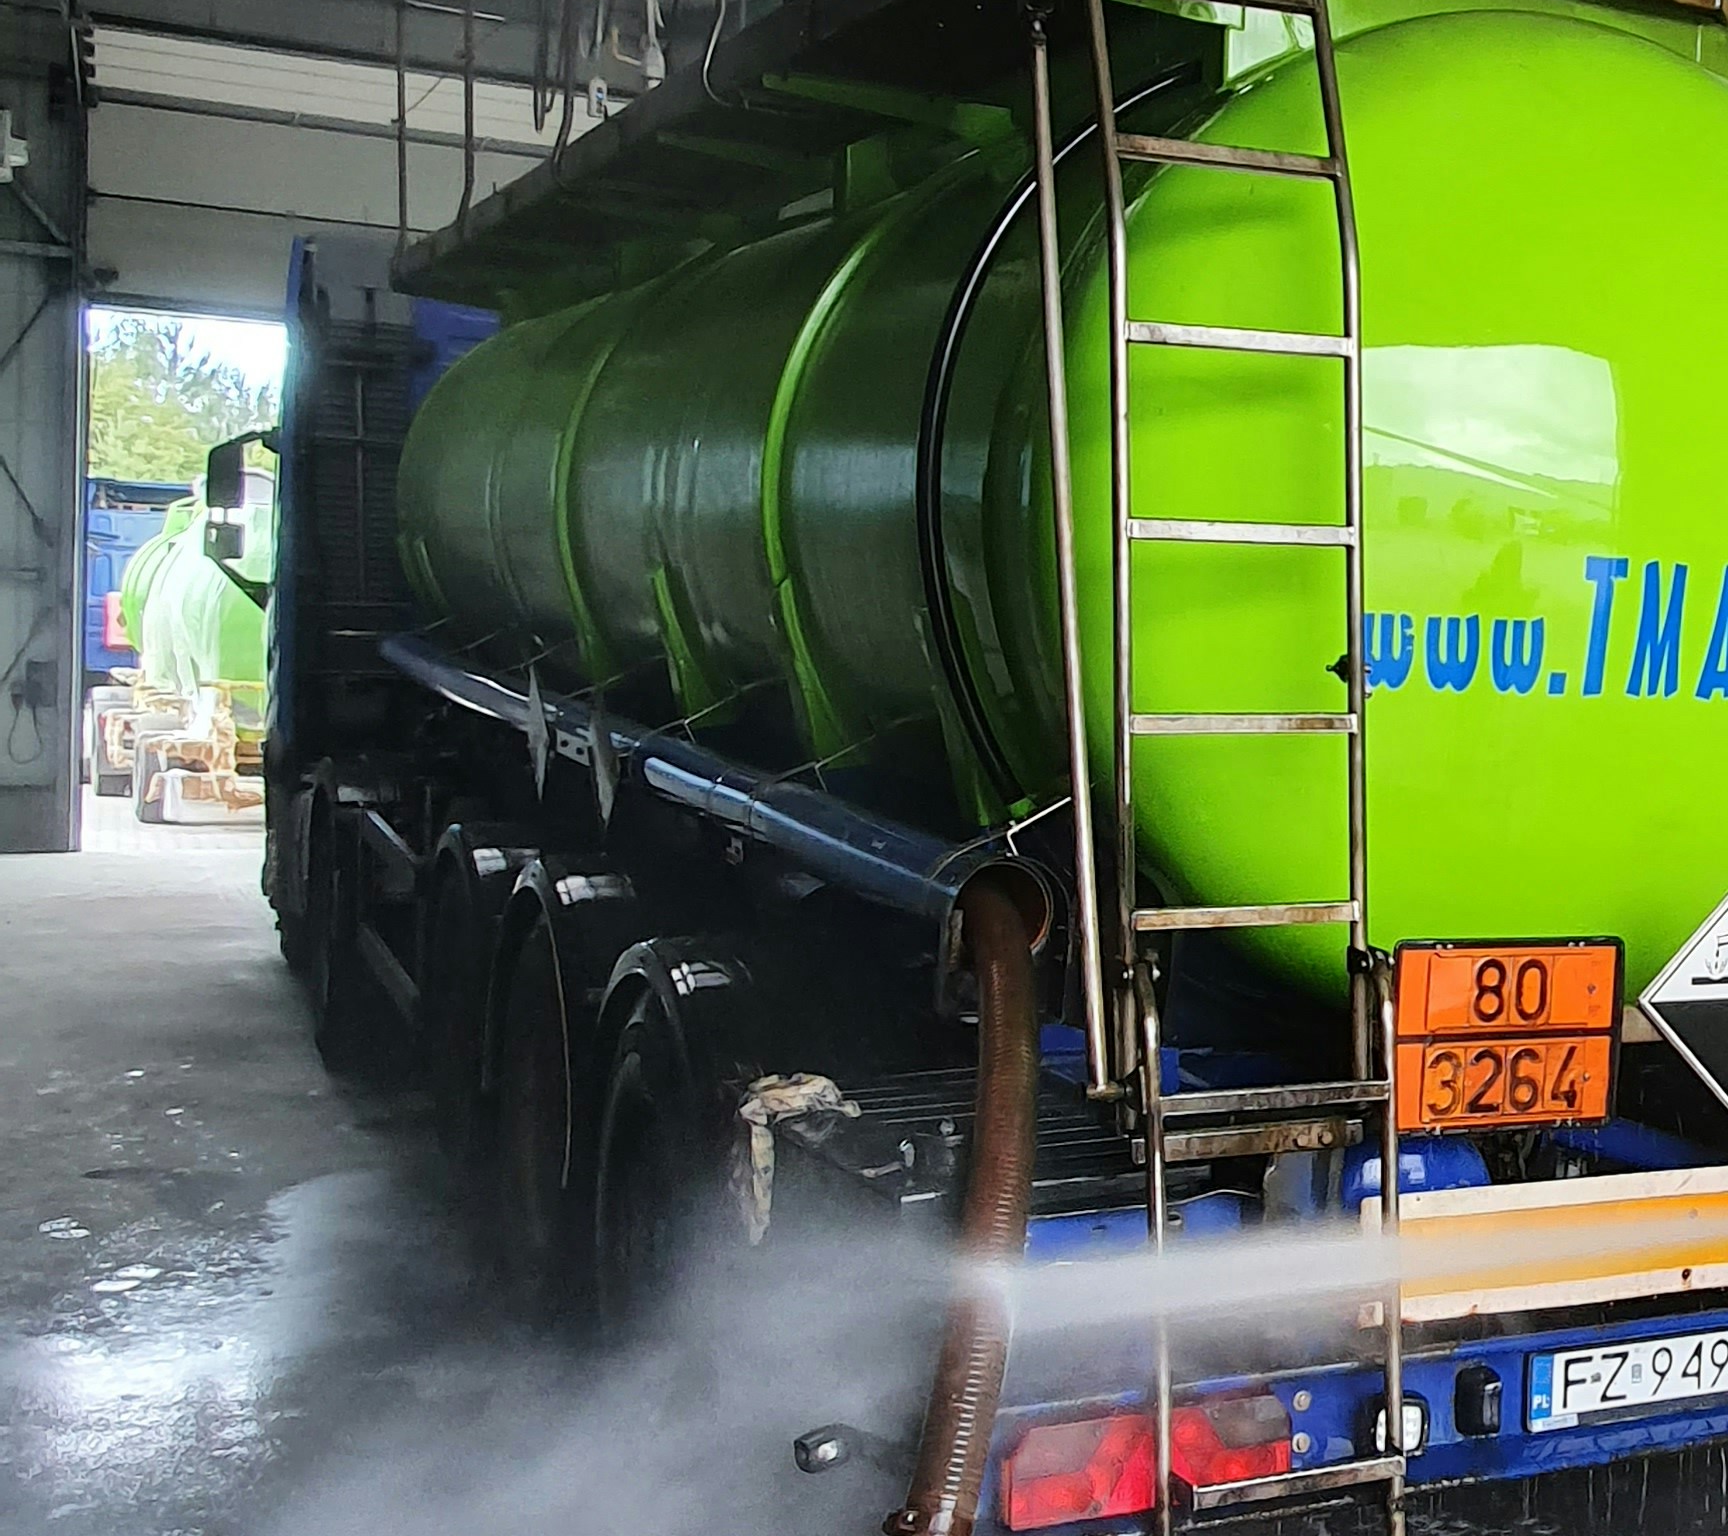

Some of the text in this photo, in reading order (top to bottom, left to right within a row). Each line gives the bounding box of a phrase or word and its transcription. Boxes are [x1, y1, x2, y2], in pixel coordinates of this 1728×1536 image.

[1473, 958, 1548, 1022] 80
[1426, 1045, 1577, 1115] 3264
[1532, 1394, 1550, 1409] PL
[1562, 1351, 1629, 1408] FZ
